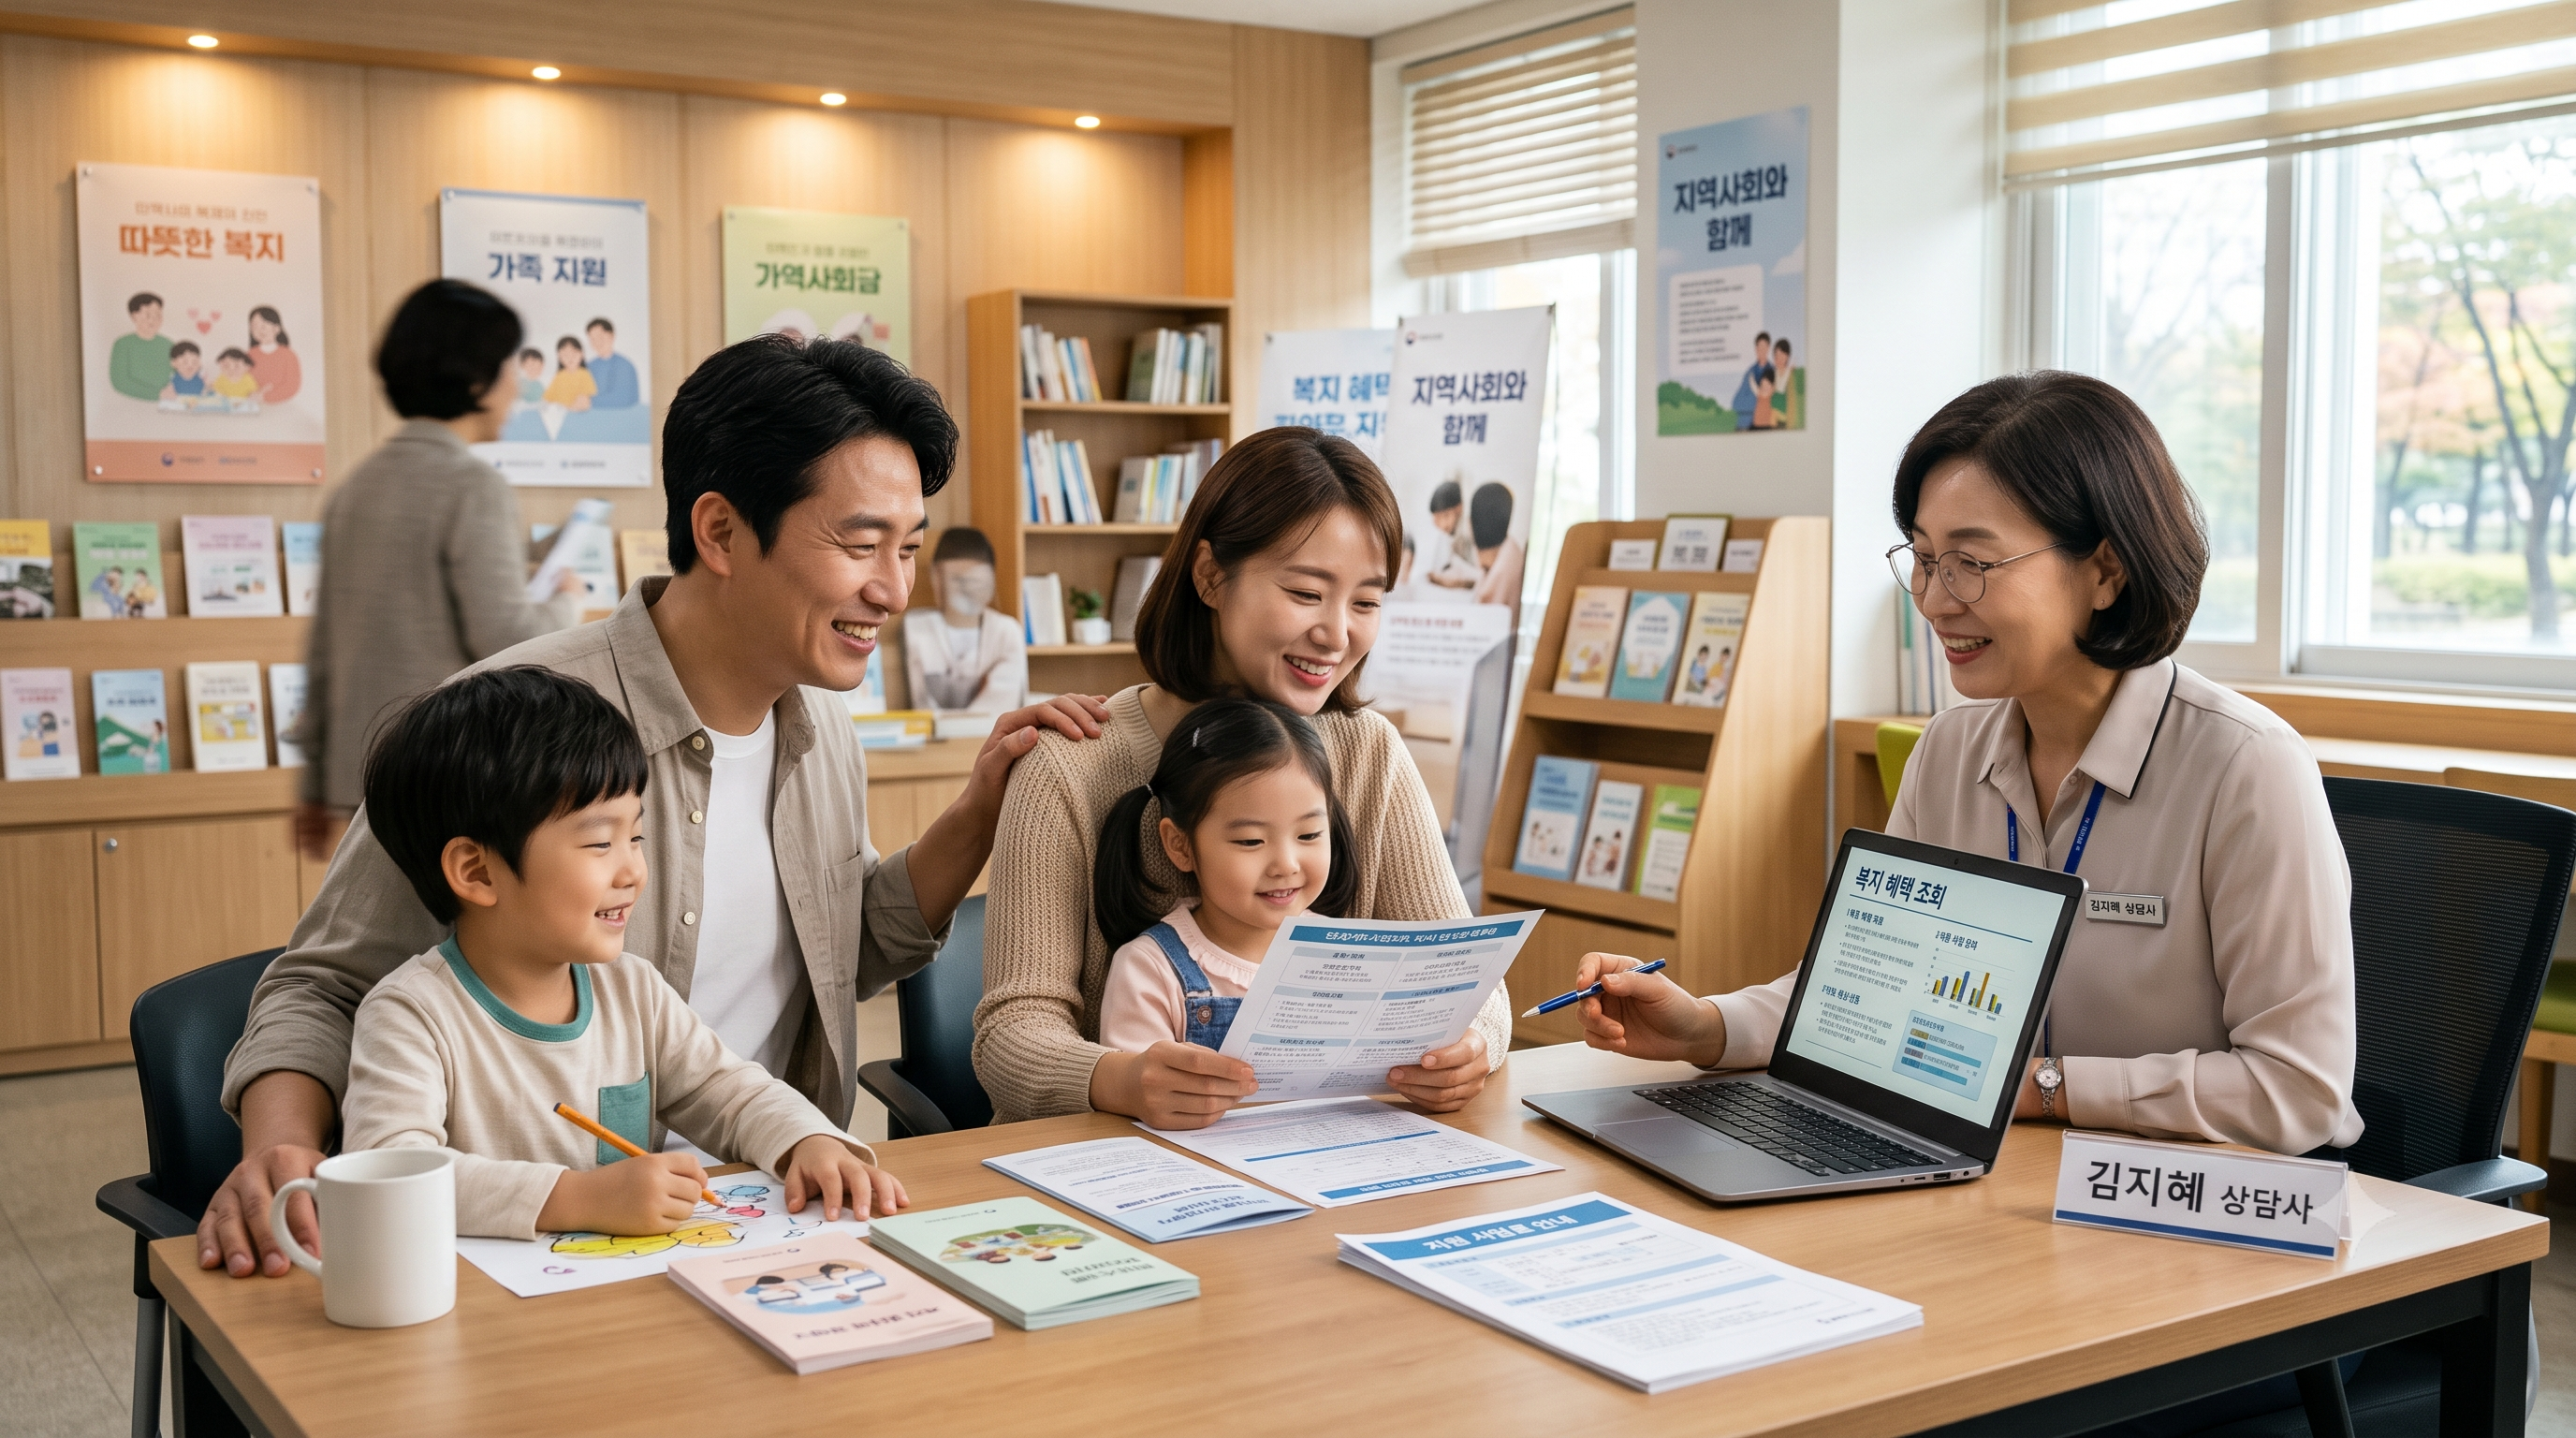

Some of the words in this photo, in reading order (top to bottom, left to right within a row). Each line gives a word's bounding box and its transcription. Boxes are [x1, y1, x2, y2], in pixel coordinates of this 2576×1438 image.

[1674, 163, 1789, 213] 지역사회와
[119, 224, 214, 259] 따뜻한
[225, 229, 285, 263] 복지
[1706, 213, 1752, 252] 함께
[488, 253, 542, 283] 가족
[553, 257, 607, 286] 지원
[1293, 375, 1340, 404] 복지
[1412, 370, 1529, 406] 지역사회와
[1442, 413, 1488, 446] 함께
[1855, 866, 1885, 895] 복지
[1913, 881, 1948, 910] 조회
[2124, 902, 2157, 917] 상담사
[2086, 1160, 2205, 1213] 김지혜
[2219, 1184, 2314, 1225] 상담사
